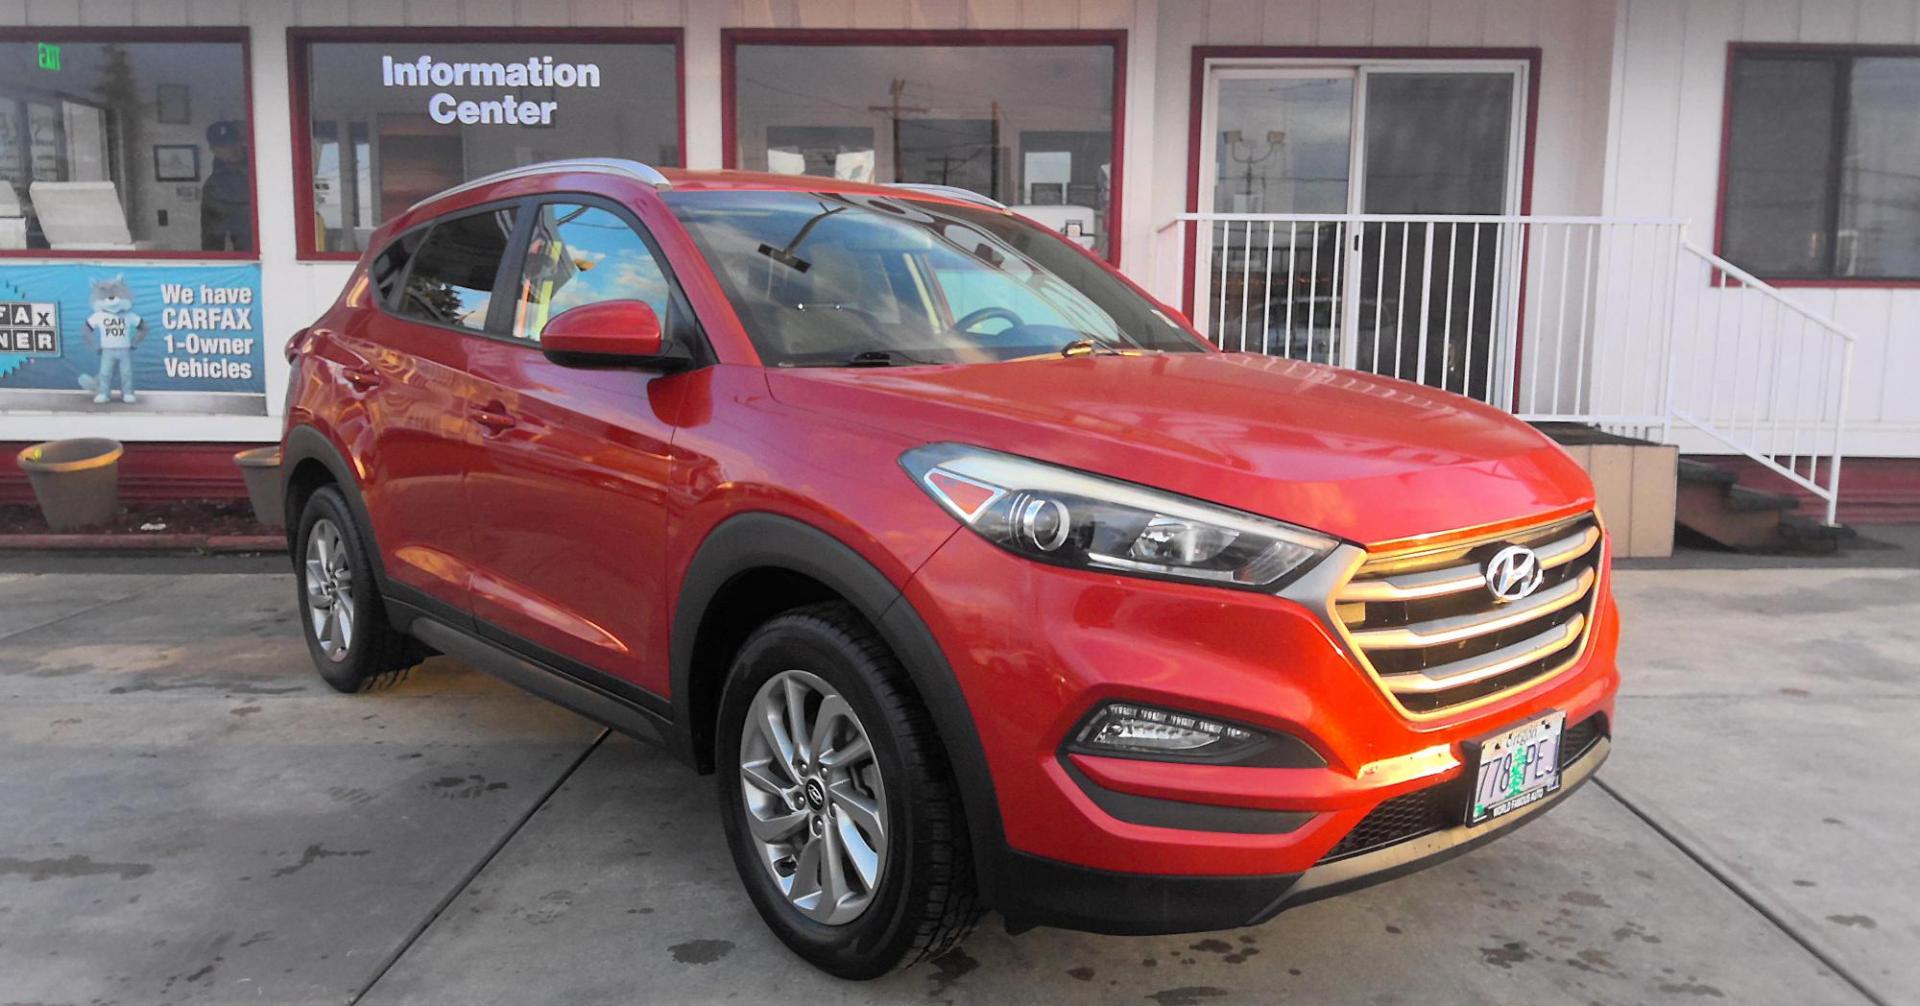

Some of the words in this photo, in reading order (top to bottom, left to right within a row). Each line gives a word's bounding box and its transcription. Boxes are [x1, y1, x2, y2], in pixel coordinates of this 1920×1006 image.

[382, 55, 600, 87] Information
[428, 92, 557, 124] Center
[161, 284, 194, 304] We
[200, 284, 253, 304] have
[103, 317, 126, 326] CAR
[162, 307, 252, 330] CARFAX
[105, 327, 126, 337] FOX
[164, 333, 253, 354] 1-Owner
[164, 357, 252, 378] Vehicles
[1478, 753, 1512, 802] 778
[1522, 735, 1560, 785] PEJ
